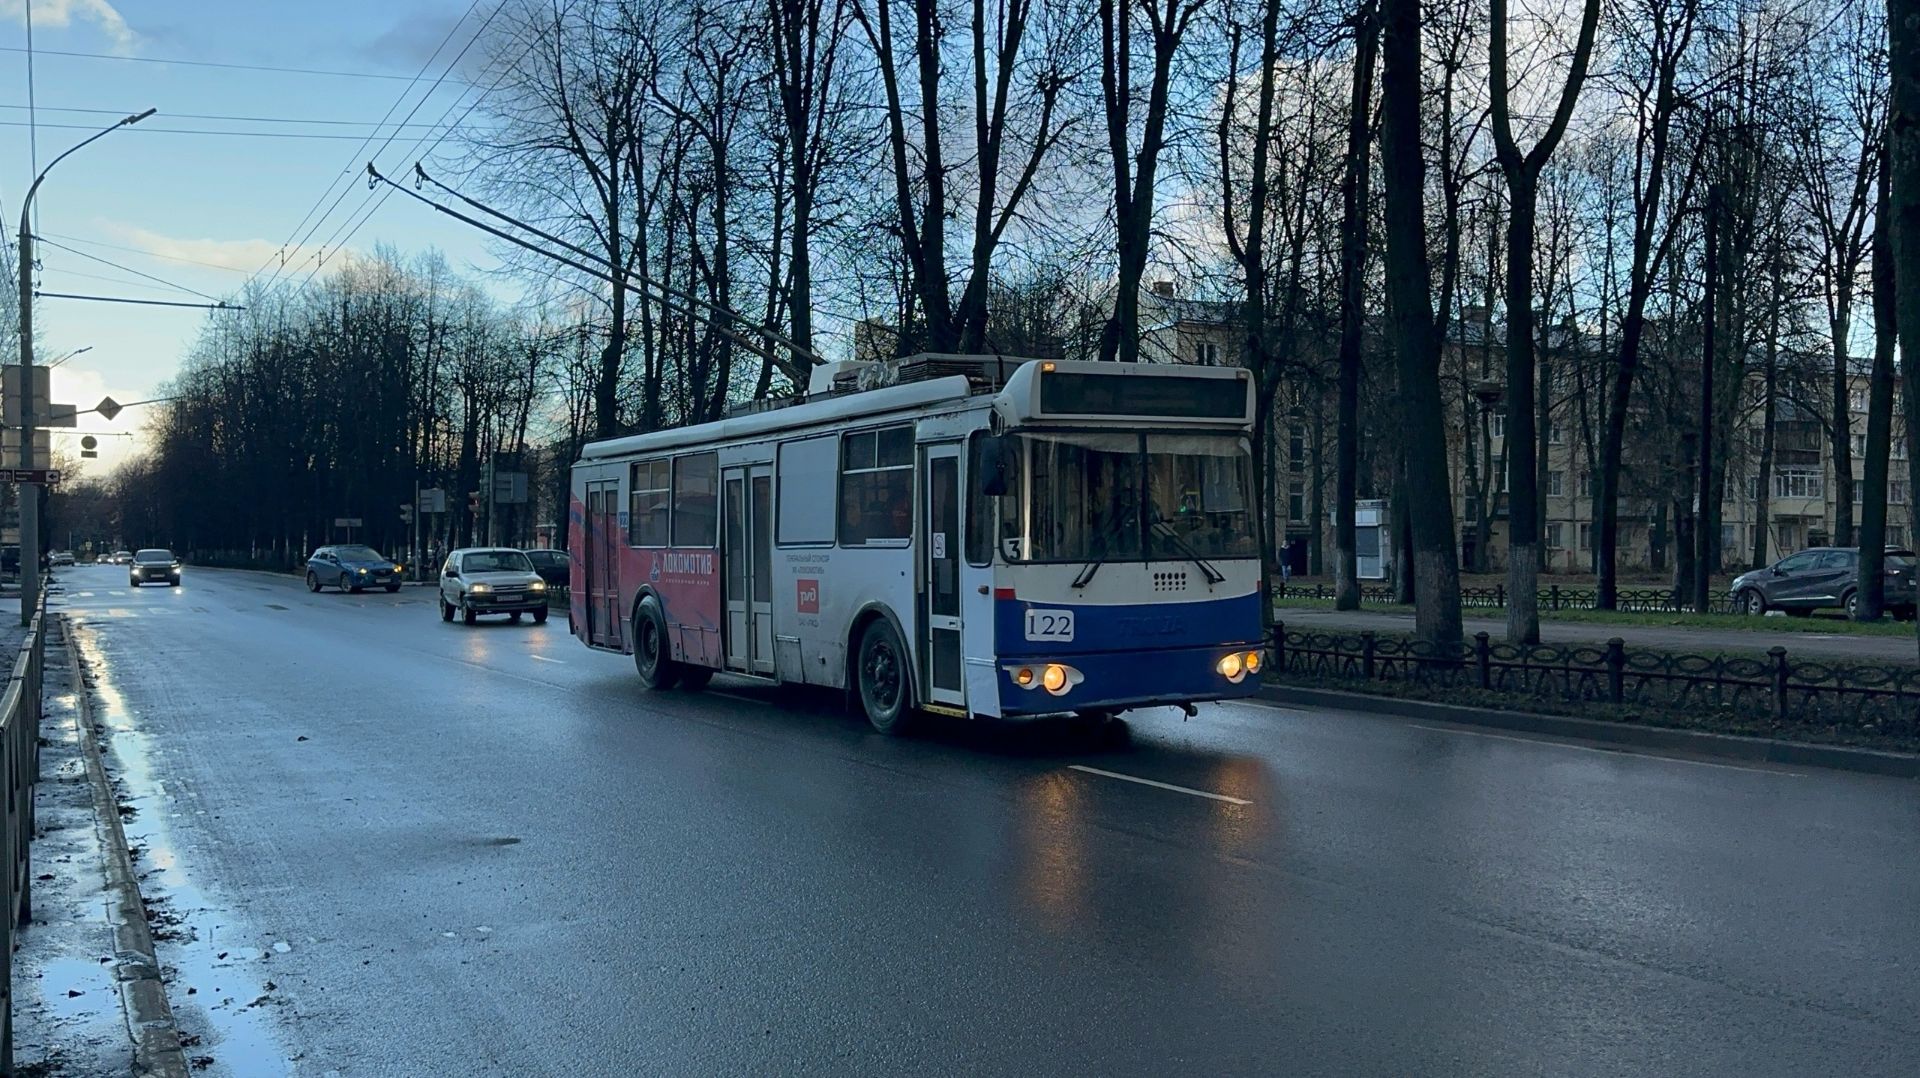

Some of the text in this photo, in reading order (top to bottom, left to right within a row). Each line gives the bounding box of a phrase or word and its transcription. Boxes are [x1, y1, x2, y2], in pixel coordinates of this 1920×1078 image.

[1009, 540, 1021, 561] 3
[662, 553, 712, 575] ЛОКОМОТИВ
[1028, 615, 1071, 635] 122
